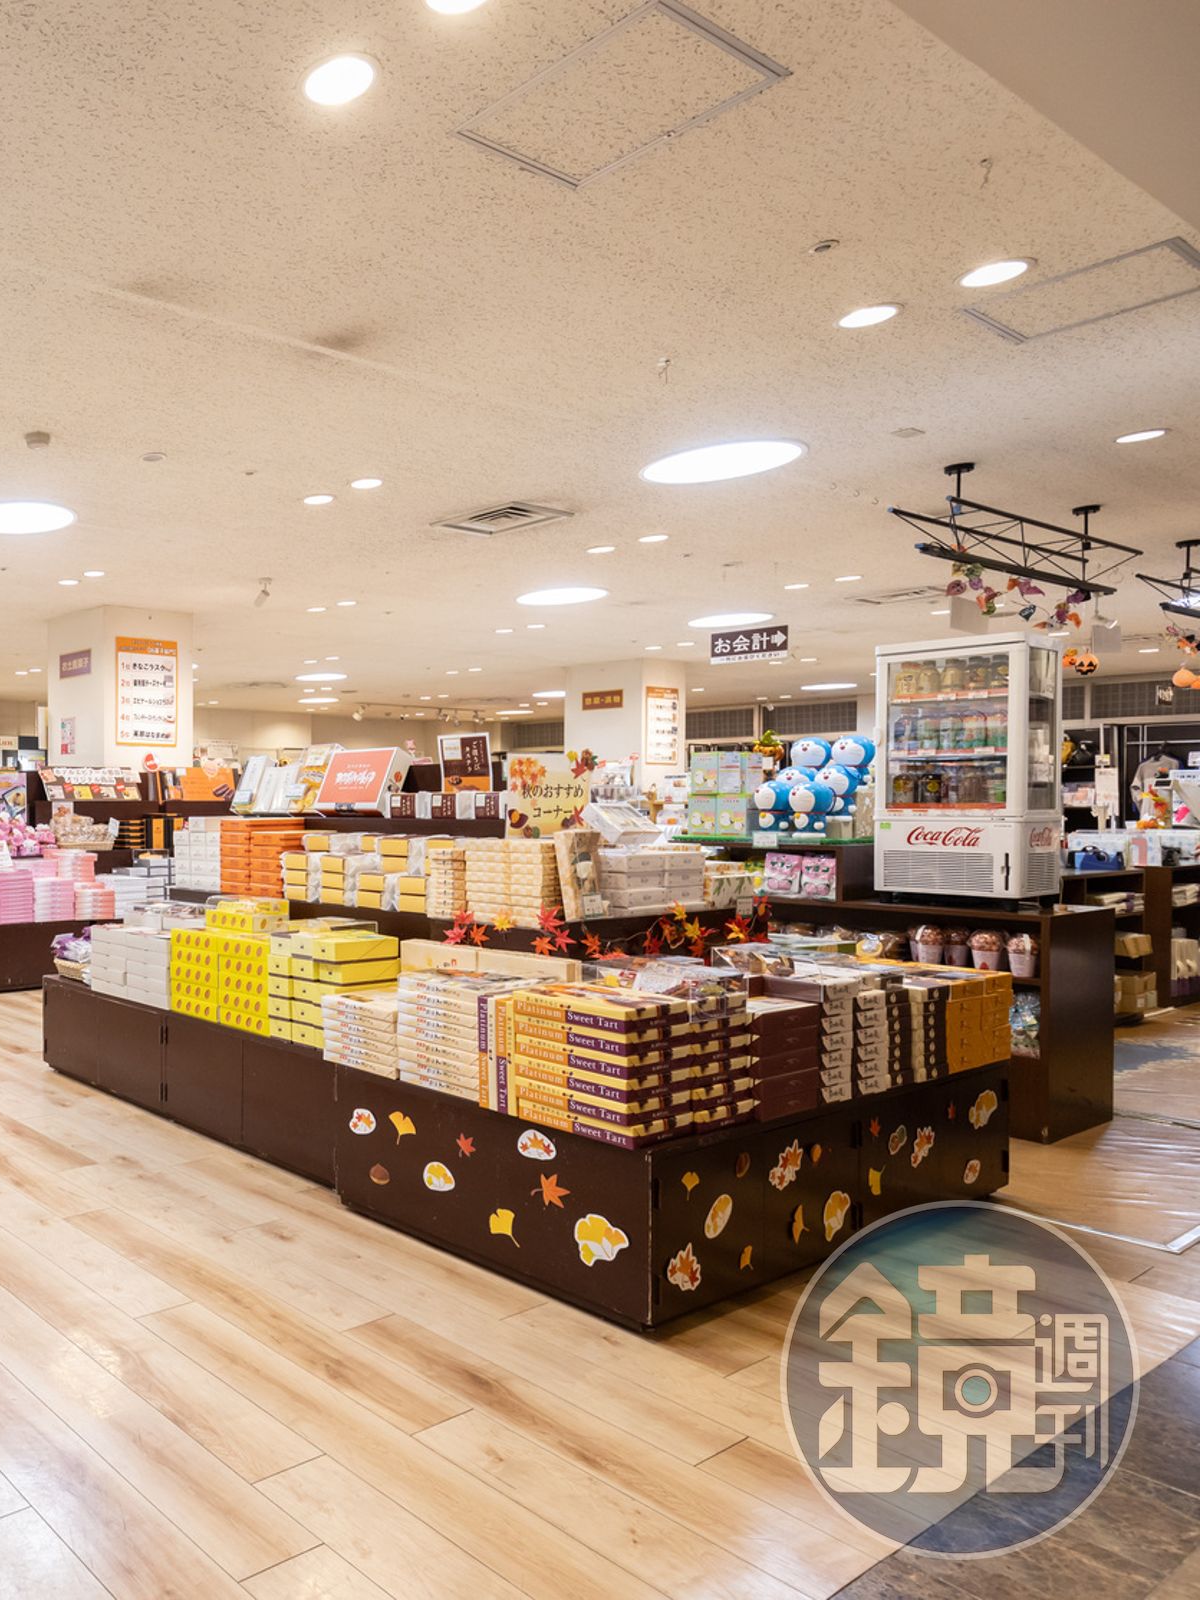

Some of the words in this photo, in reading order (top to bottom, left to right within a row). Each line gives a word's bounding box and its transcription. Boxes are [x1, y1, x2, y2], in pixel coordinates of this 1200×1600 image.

[714, 632, 770, 654] お会計
[522, 784, 584, 799] 秋のおすすめ
[533, 805, 572, 819] コーナー
[907, 826, 985, 847] Coca-Cola
[517, 1001, 562, 1018] Platinum
[567, 1011, 594, 1025] Sweet
[597, 1017, 618, 1030] Tart
[518, 1023, 563, 1040] Platinum
[569, 1033, 595, 1048] Sweet
[598, 1039, 619, 1053] Tart
[519, 1043, 564, 1062] Platinum
[570, 1055, 596, 1070] Sweet
[599, 1062, 621, 1076] Tart
[519, 1066, 563, 1084] Platinum
[569, 1078, 596, 1093] Sweet
[599, 1085, 621, 1100] Tart
[520, 1088, 564, 1107] Platinum
[569, 1101, 596, 1116] Sweet
[599, 1108, 621, 1123] Tart
[523, 1109, 569, 1129] Platinum
[574, 1123, 601, 1138] Sweet
[604, 1130, 627, 1145] Tart
